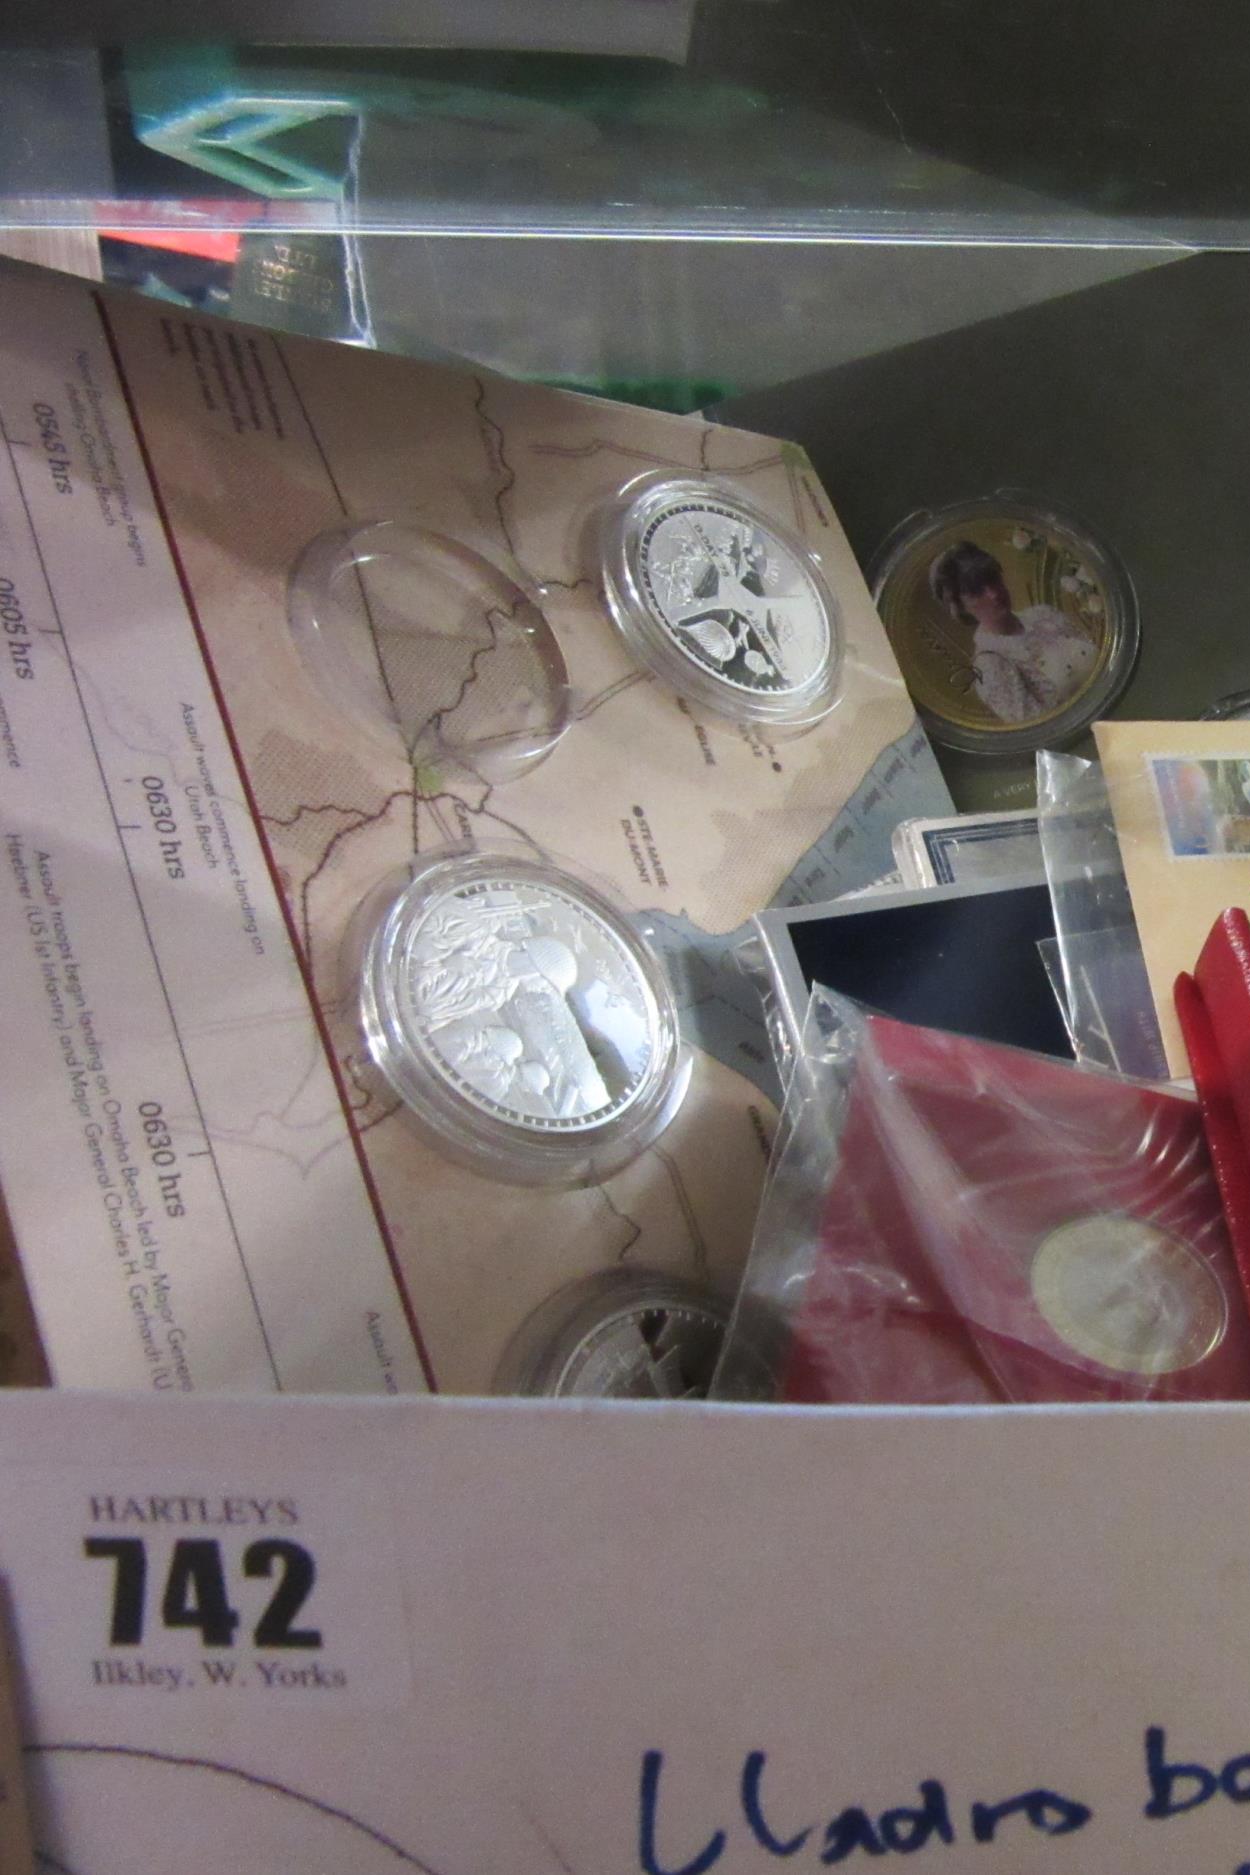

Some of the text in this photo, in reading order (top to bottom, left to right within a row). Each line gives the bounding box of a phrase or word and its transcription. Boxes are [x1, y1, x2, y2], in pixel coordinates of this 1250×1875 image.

[33, 402, 72, 494] 0545 hrs
[96, 486, 116, 527] Beach
[127, 524, 144, 566] begins
[8, 641, 34, 680] hrs
[142, 776, 184, 879] 0630 hrs
[182, 703, 265, 955] Assault waves commence landing on
[184, 785, 217, 868] Utah Beach
[37, 851, 192, 1391] Assault troops begin landing on Omaha Beach led by Major Genera
[139, 1102, 184, 1218] 0630 hrs
[59, 1035, 82, 1068] and
[71, 1070, 90, 1118] Major
[85, 1123, 113, 1189] General
[104, 1192, 129, 1257] Charles
[129, 1284, 160, 1362] Gerhardt
[90, 1496, 299, 1526] HARTLEYS
[85, 1537, 322, 1650] 742
[202, 1661, 246, 1687] W.
[256, 1661, 347, 1688] Yorks
